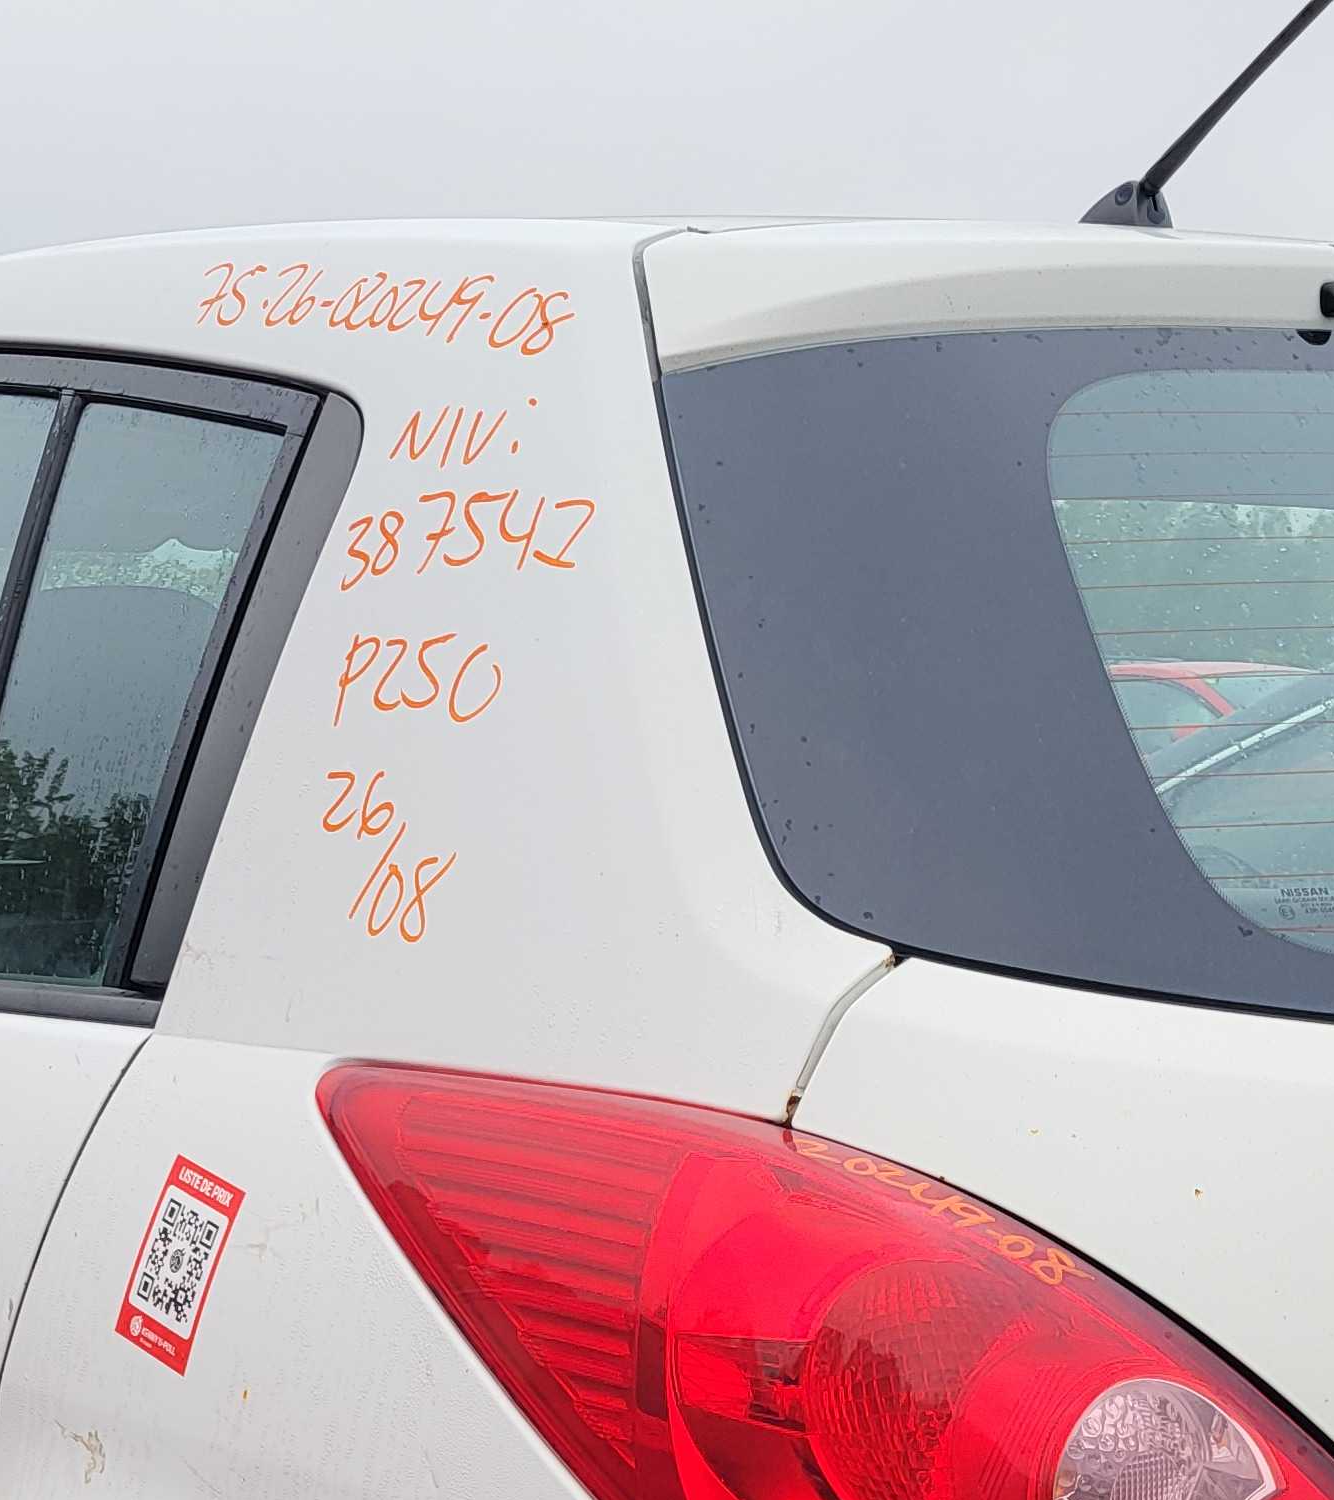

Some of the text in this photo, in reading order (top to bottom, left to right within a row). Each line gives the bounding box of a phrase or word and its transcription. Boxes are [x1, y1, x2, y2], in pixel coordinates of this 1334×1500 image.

[334, 633, 502, 727] P250
[1280, 887, 1329, 897] NISSAN
[178, 1166, 234, 1207] LISTE DE PRIX
